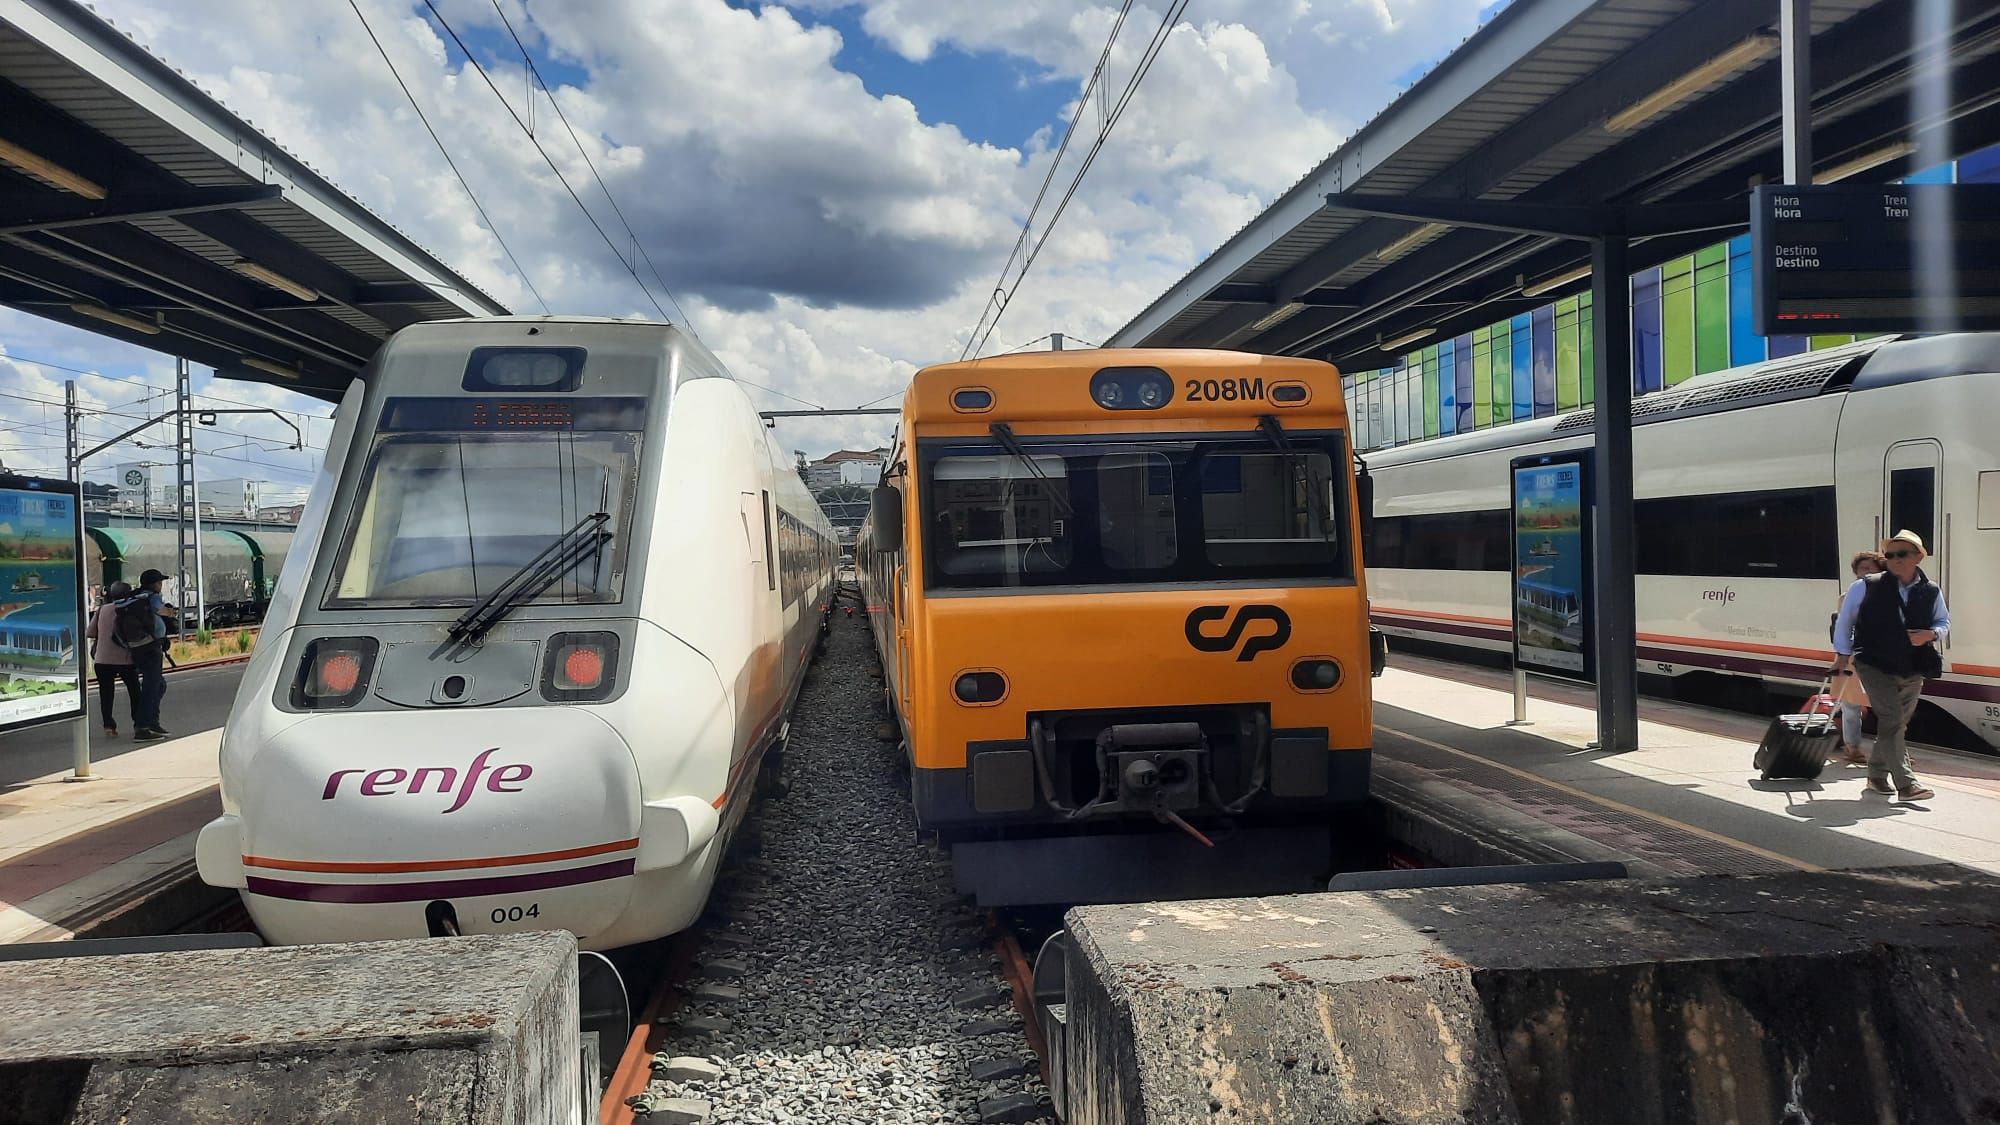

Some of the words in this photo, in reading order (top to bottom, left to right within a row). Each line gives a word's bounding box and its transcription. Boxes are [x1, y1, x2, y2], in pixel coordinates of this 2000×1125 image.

[1774, 195, 1800, 206] Hora
[1884, 194, 1907, 206] Tren
[1774, 207, 1802, 218] Hora
[1884, 206, 1909, 217] Tren
[1775, 245, 1817, 256] Destino
[1775, 256, 1820, 268] Destino
[1185, 377, 1264, 402] 208M
[1702, 585, 1736, 607] renfe
[1184, 604, 1292, 662] CP
[1985, 705, 2000, 717] 96
[322, 746, 534, 814] renfe
[490, 903, 540, 924] 004
